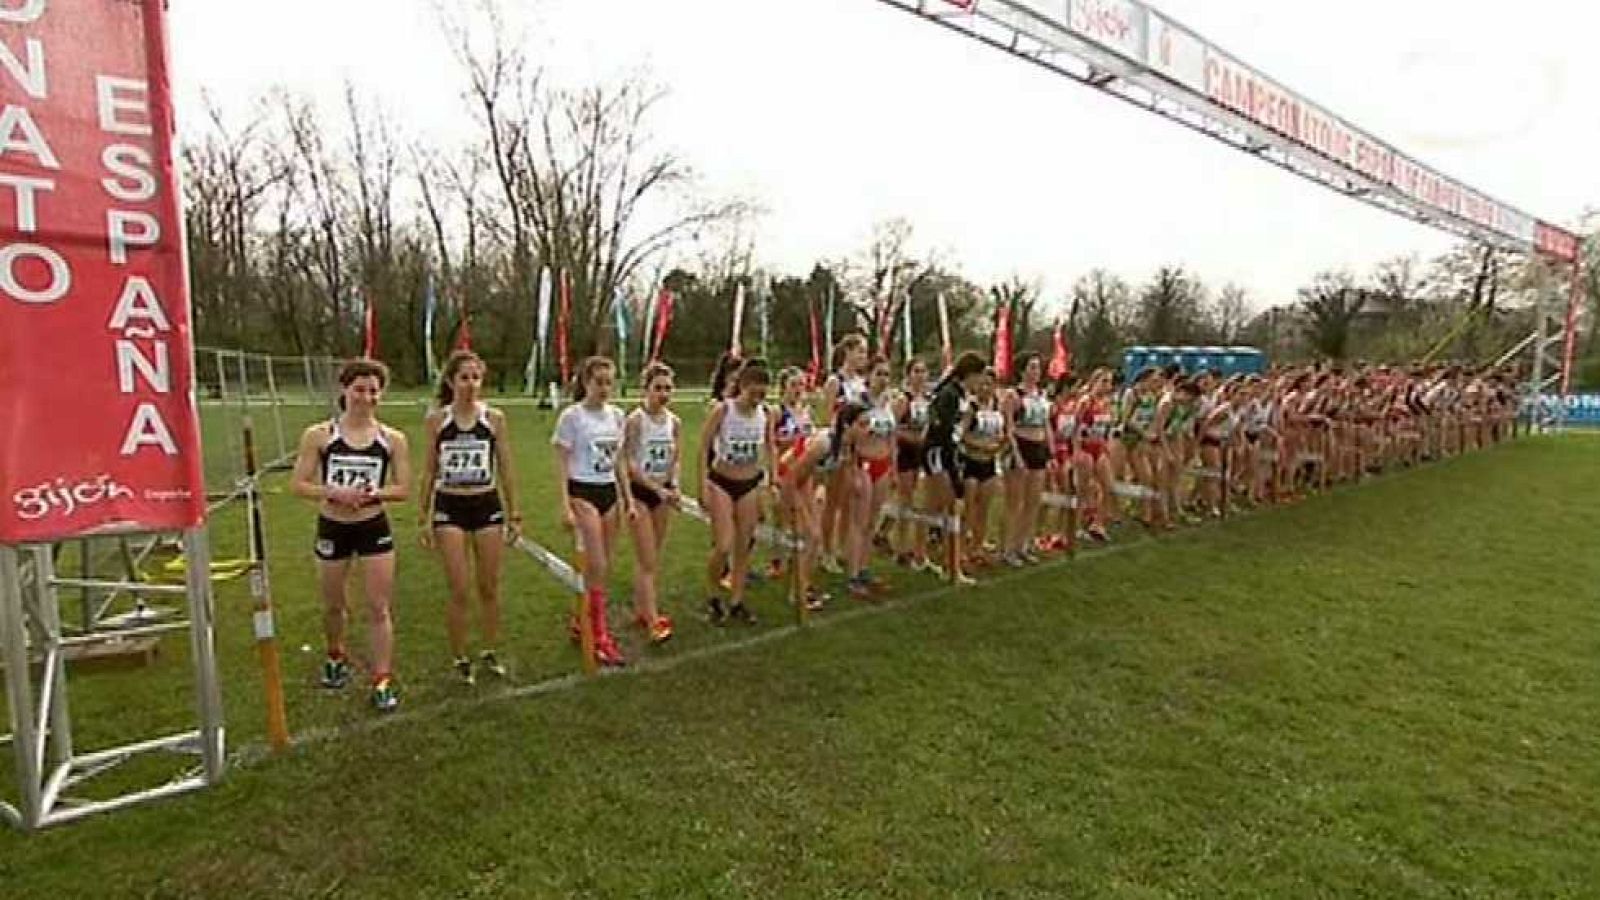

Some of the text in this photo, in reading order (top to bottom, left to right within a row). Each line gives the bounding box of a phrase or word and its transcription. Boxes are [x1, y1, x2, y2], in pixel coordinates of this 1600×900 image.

[97, 74, 178, 456] ESPAÑA
[447, 452, 482, 468] 474
[332, 468, 371, 489] 475
